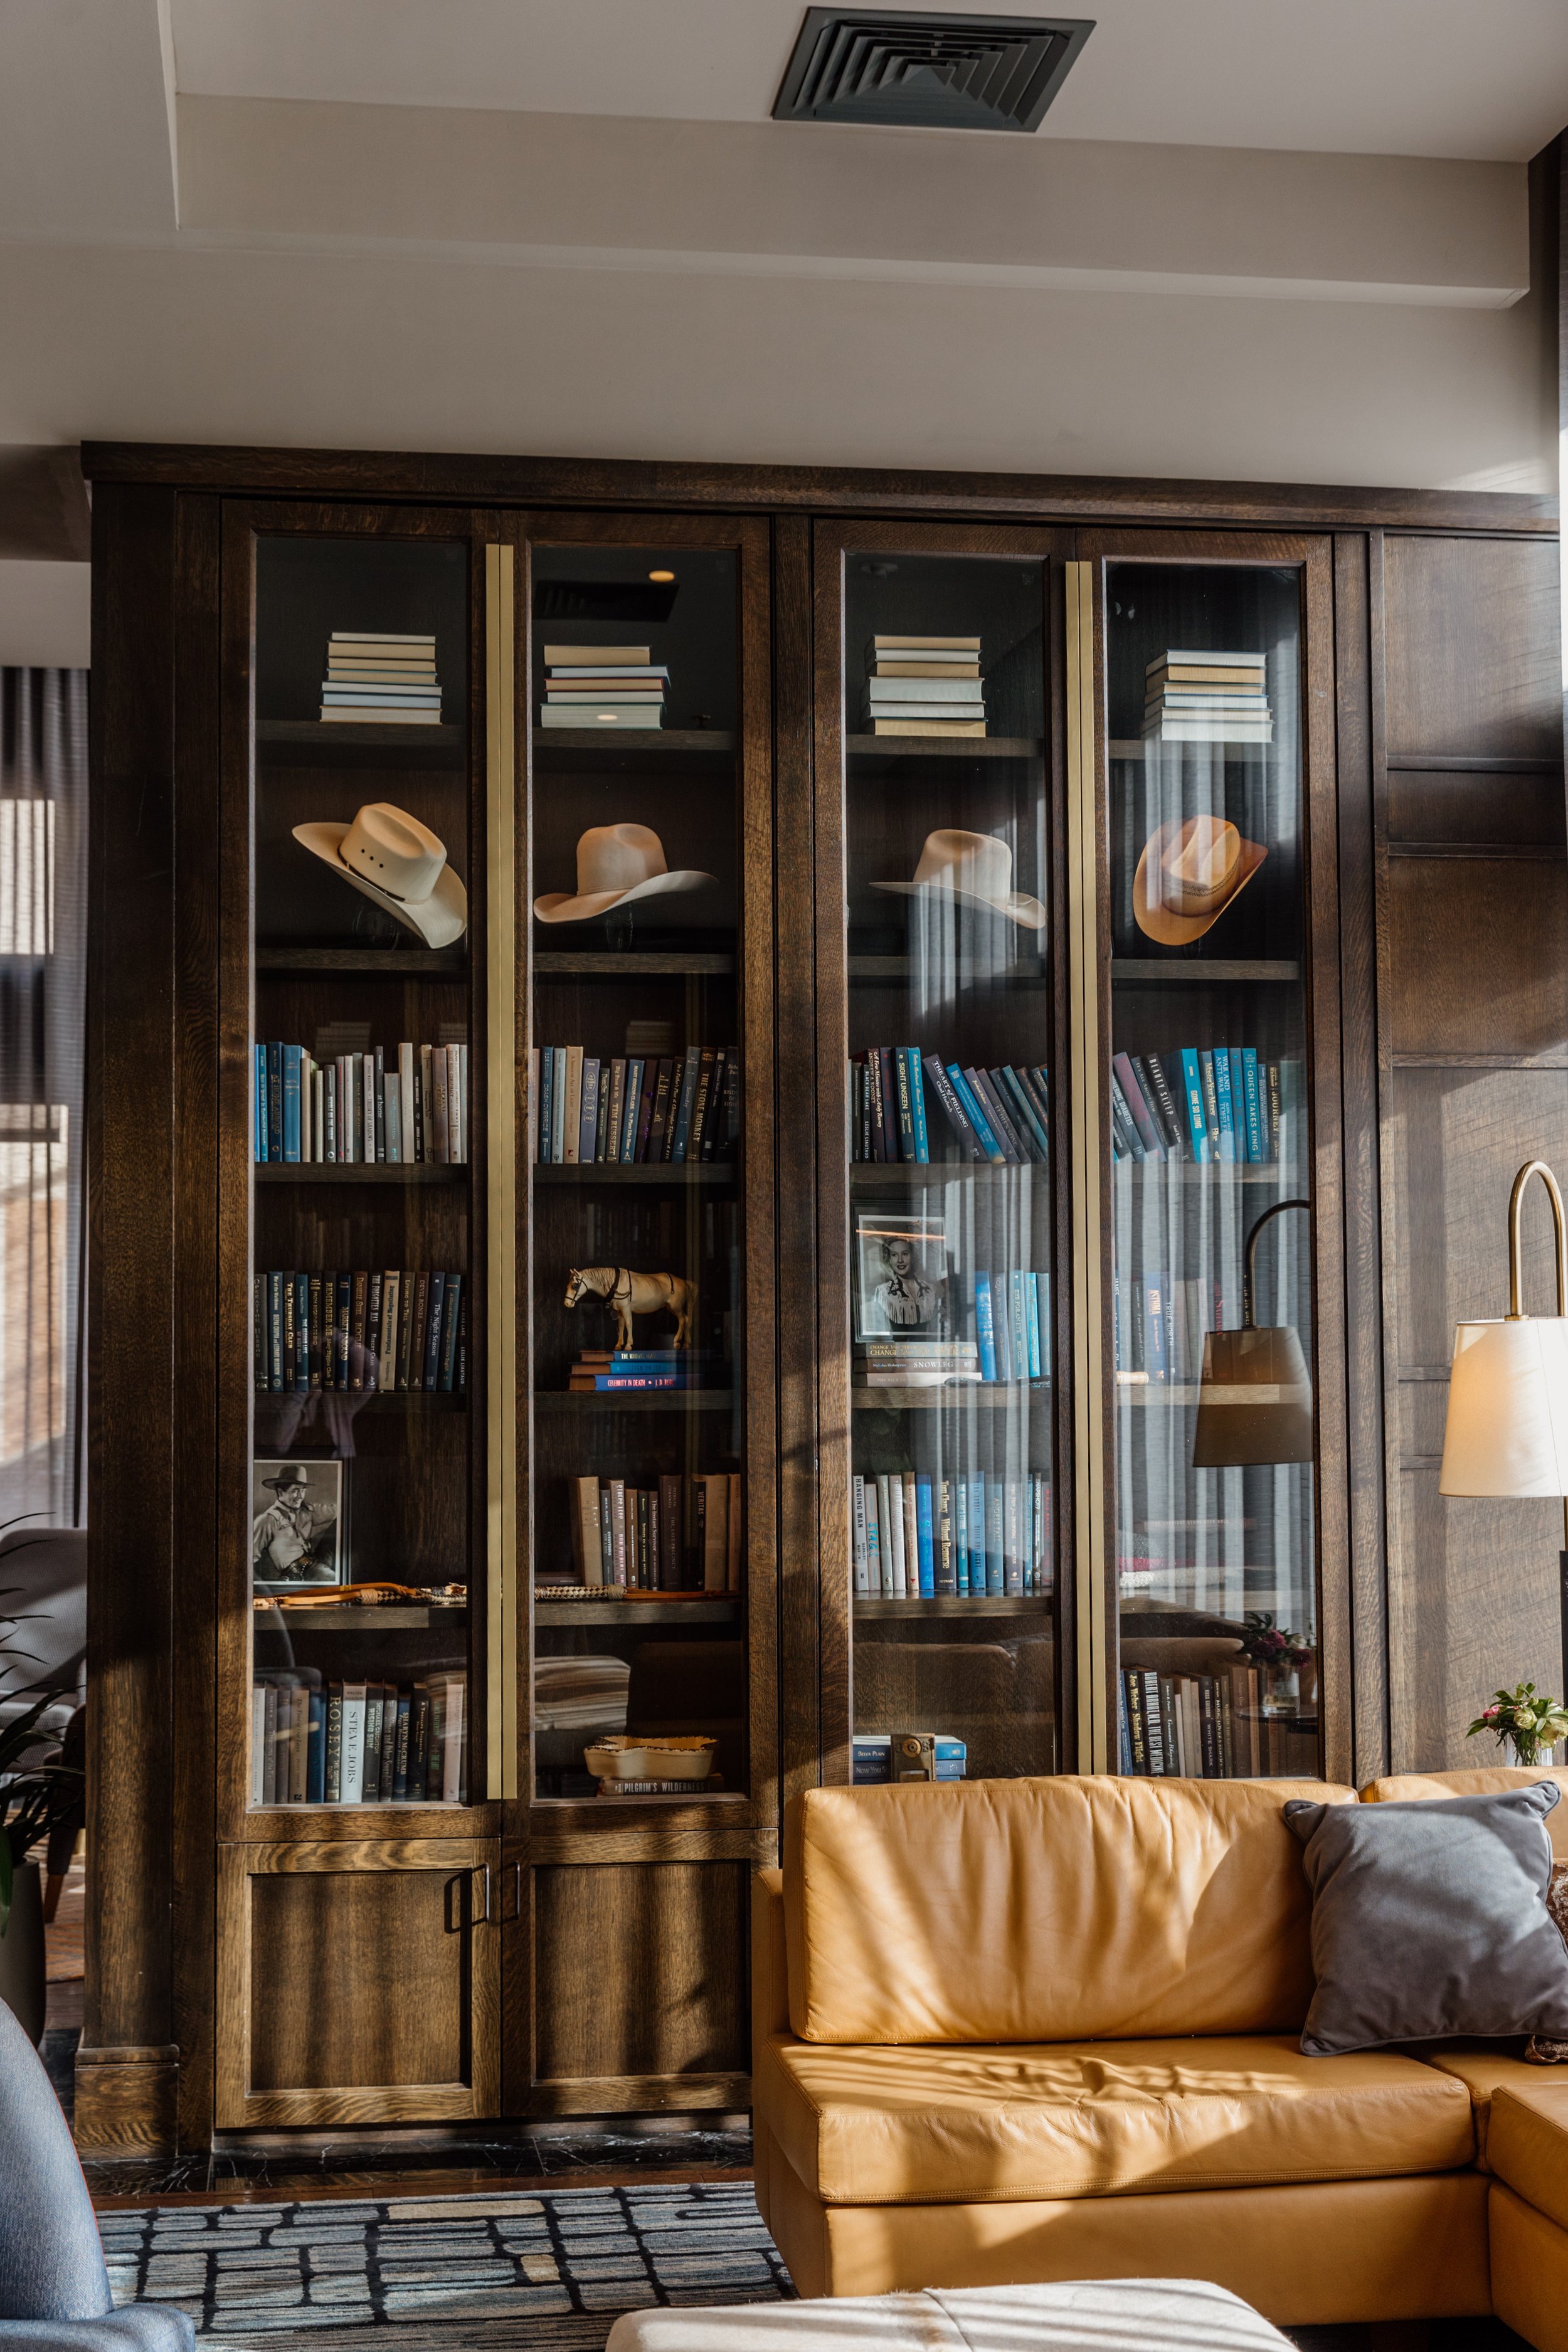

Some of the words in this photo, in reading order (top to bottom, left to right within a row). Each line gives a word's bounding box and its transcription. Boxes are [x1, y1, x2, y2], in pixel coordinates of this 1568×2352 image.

[273, 1074, 280, 1084] AT
[700, 1073, 709, 1087] THE
[1149, 1058, 1165, 1089] BEAUTY
[1160, 1092, 1173, 1115] SLEEP
[1247, 1070, 1255, 1099] QUEEN
[683, 1086, 692, 1108] Saturday
[697, 1089, 707, 1110] STONE
[900, 1083, 908, 1109] UNSEEN
[933, 1061, 944, 1076] THE
[939, 1074, 950, 1089] ART
[950, 1096, 968, 1128] FIELDING
[936, 1081, 945, 1094] Chad
[941, 1094, 953, 1113] Harbach
[1119, 1101, 1133, 1126] DIABETES
[1207, 1097, 1216, 1116] Money
[692, 1112, 704, 1142] MONKEY
[1193, 1115, 1202, 1128] LONG
[609, 1120, 618, 1156] RUSSERT
[372, 1275, 380, 1284] THE
[371, 1285, 379, 1310] FORGOTTEN
[387, 1285, 395, 1314] Negotiating
[1148, 1290, 1161, 1315] ASTHMA
[370, 1312, 378, 1322] MAN
[326, 1325, 332, 1336] ME
[431, 1335, 439, 1356] Season
[940, 1480, 949, 1493] Tom
[938, 1495, 950, 1513] Clancy
[941, 1518, 950, 1542] Without
[942, 1542, 951, 1569] Remorse
[1144, 1672, 1158, 1693] ROBERT
[1130, 1688, 1139, 1710] Weber
[1146, 1694, 1160, 1714] ARNOT,
[329, 1697, 341, 1757] ROSEY
[349, 1711, 358, 1751] STEVE
[1132, 1713, 1141, 1740] Shadow
[1148, 1726, 1162, 1735] THE
[384, 1734, 393, 1744] and
[1148, 1736, 1163, 1749] BEST
[383, 1745, 392, 1759] Other
[1135, 1741, 1143, 1763] Flight
[1150, 1749, 1164, 1774] MEDICINE
[347, 1754, 356, 1784] JOBS
[624, 1783, 657, 1793] PILGRIM'S
[662, 1782, 703, 1792] WILDERNESS
